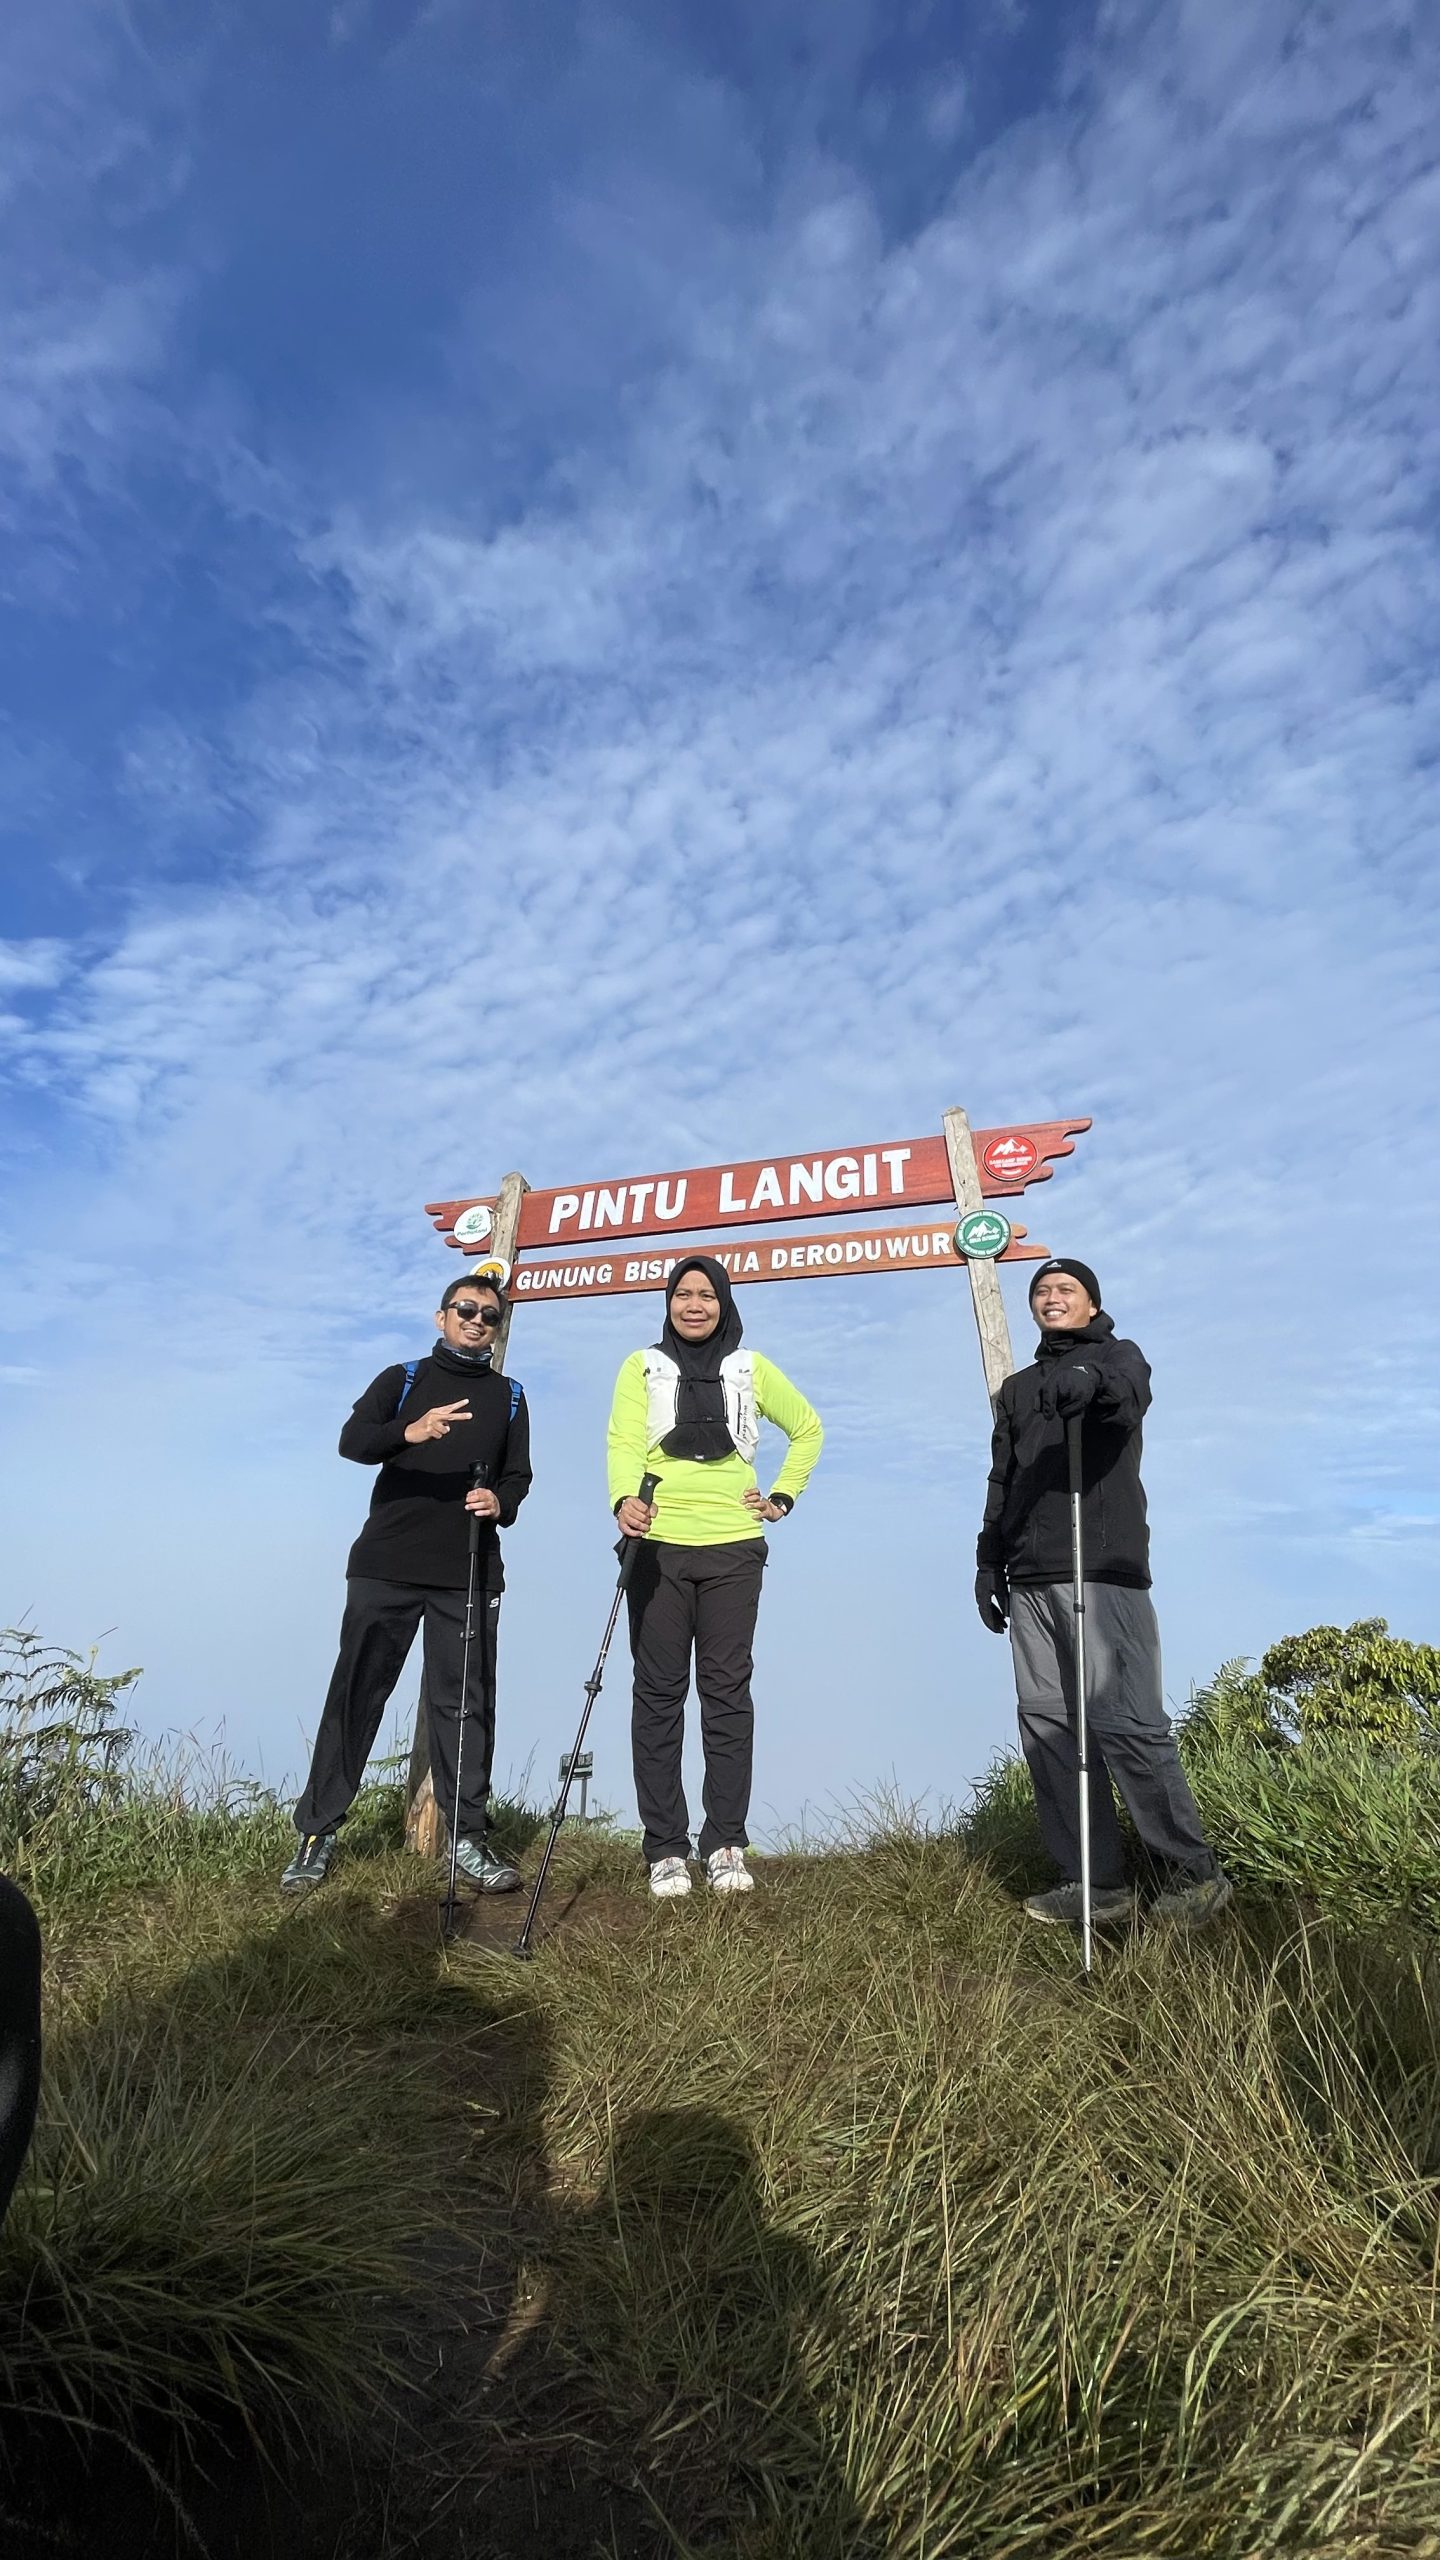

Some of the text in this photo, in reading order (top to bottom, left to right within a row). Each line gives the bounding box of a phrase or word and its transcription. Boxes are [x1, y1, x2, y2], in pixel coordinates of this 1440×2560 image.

[548, 1148, 911, 1234] PINTU LANGIT
[516, 1263, 613, 1291] GUNUNG
[714, 1251, 760, 1273] VIA
[770, 1232, 951, 1270] DERODUWUR
